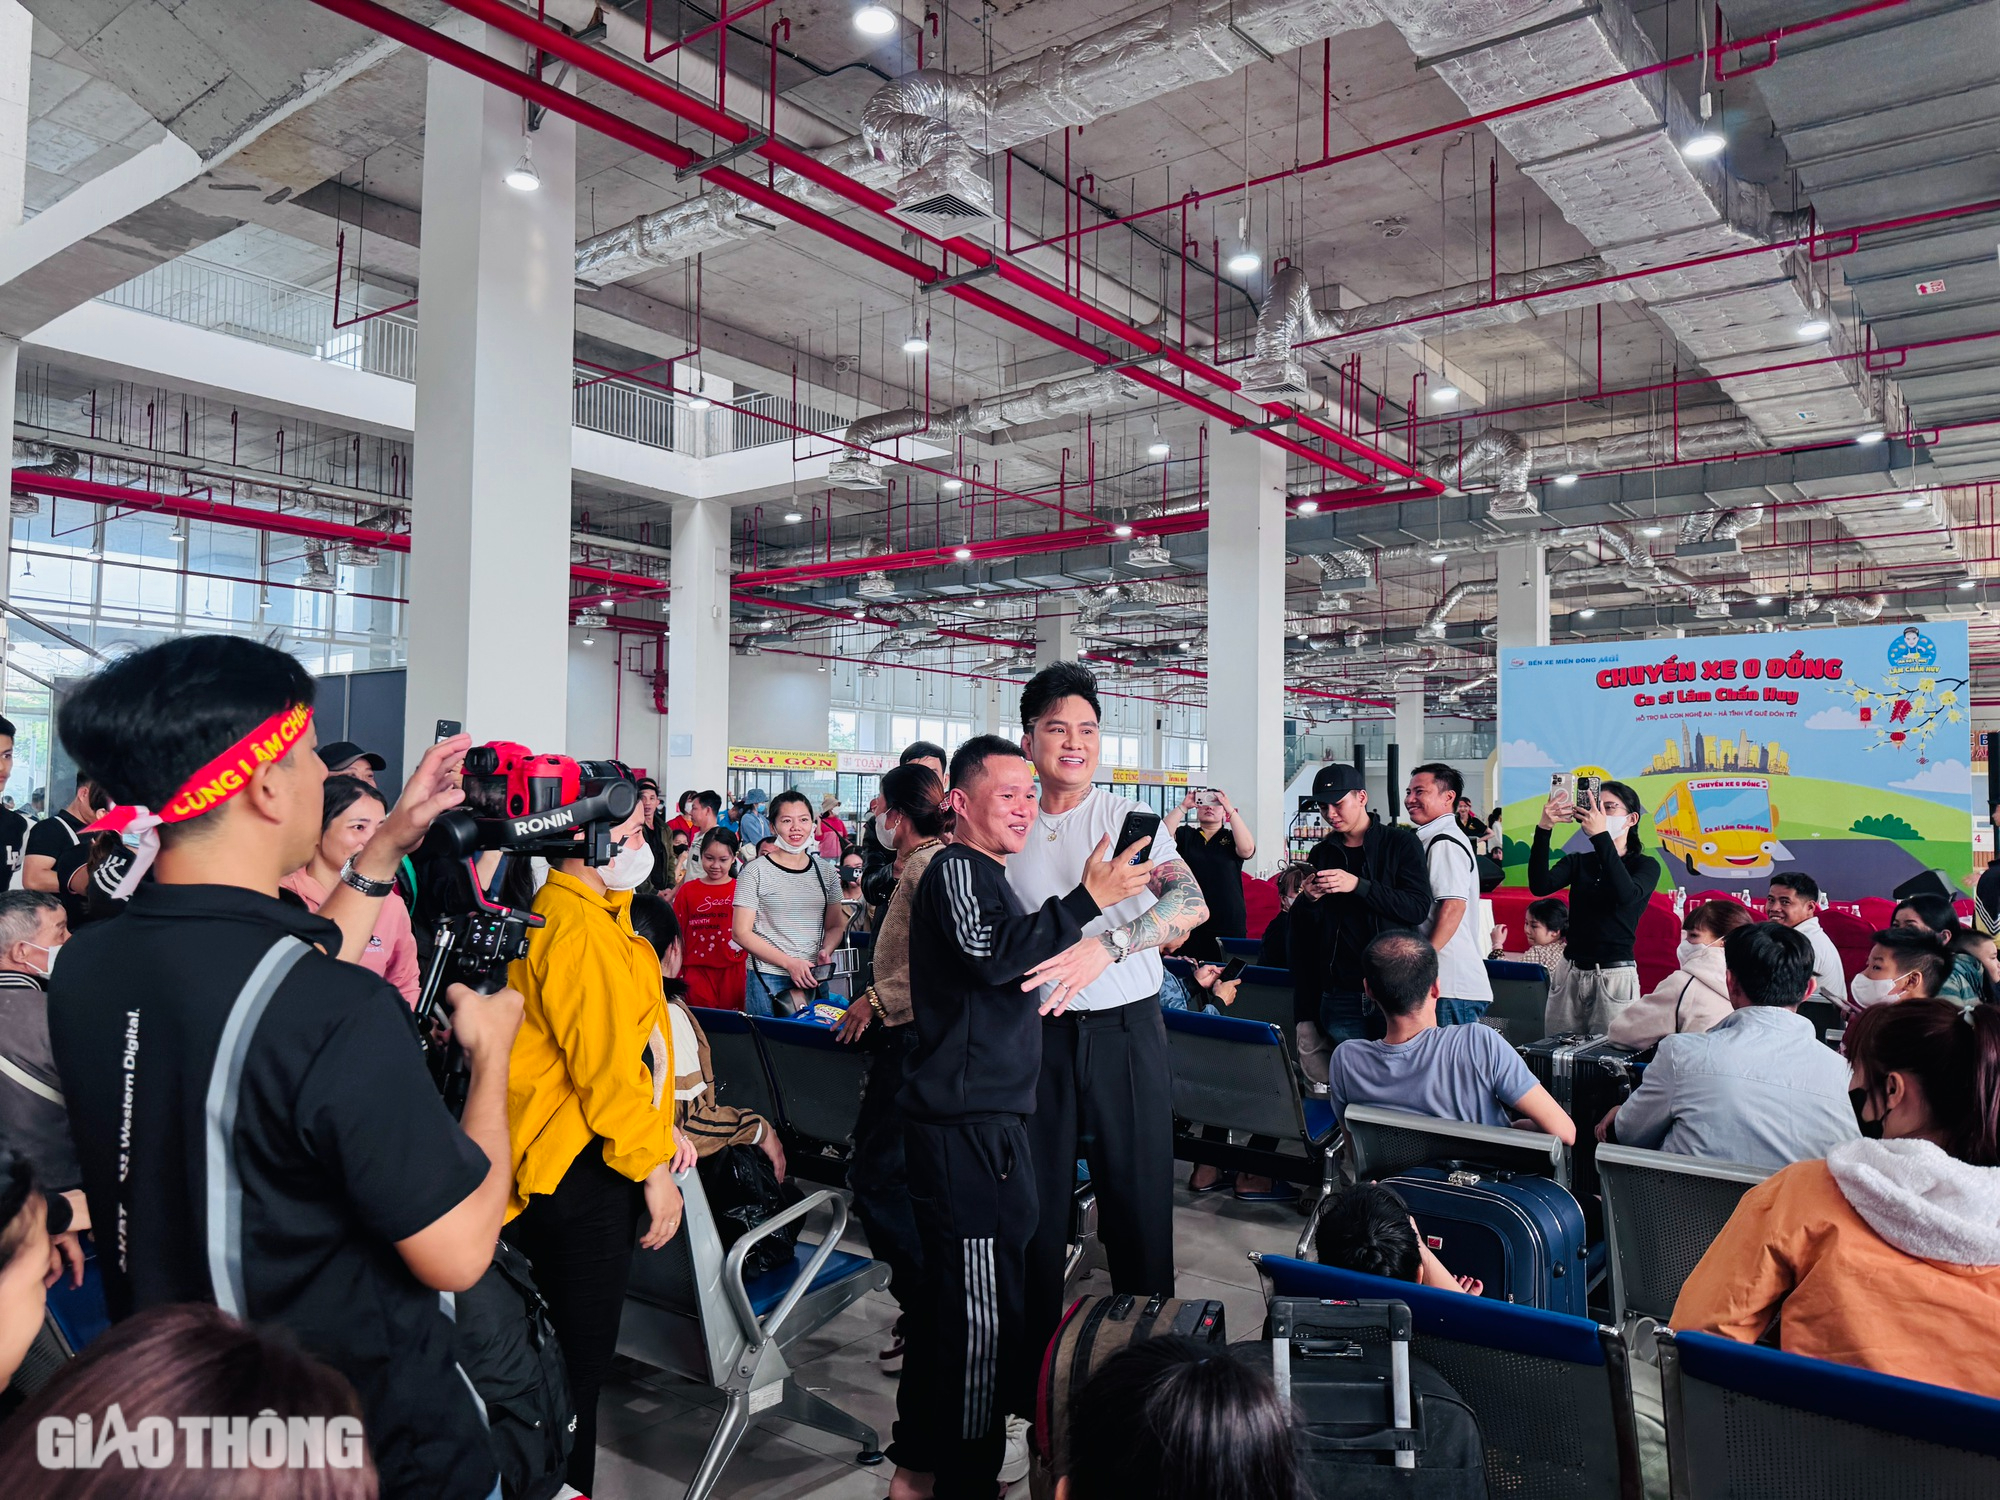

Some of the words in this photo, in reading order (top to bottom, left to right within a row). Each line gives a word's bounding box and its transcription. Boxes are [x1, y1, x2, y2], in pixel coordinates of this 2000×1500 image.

[1596, 654, 1696, 689] CHUYẾN
[1701, 659, 1738, 680] XE
[1766, 649, 1844, 680] ĐỒNG
[1634, 693, 1656, 707] Ca
[1677, 688, 1712, 703] Lâm
[1714, 684, 1759, 703] Chấn
[1763, 686, 1799, 705] Huy
[734, 754, 775, 764] SÀI
[785, 757, 832, 766] GÒN
[514, 810, 574, 836] RONIN
[120, 1073, 135, 1149] Western
